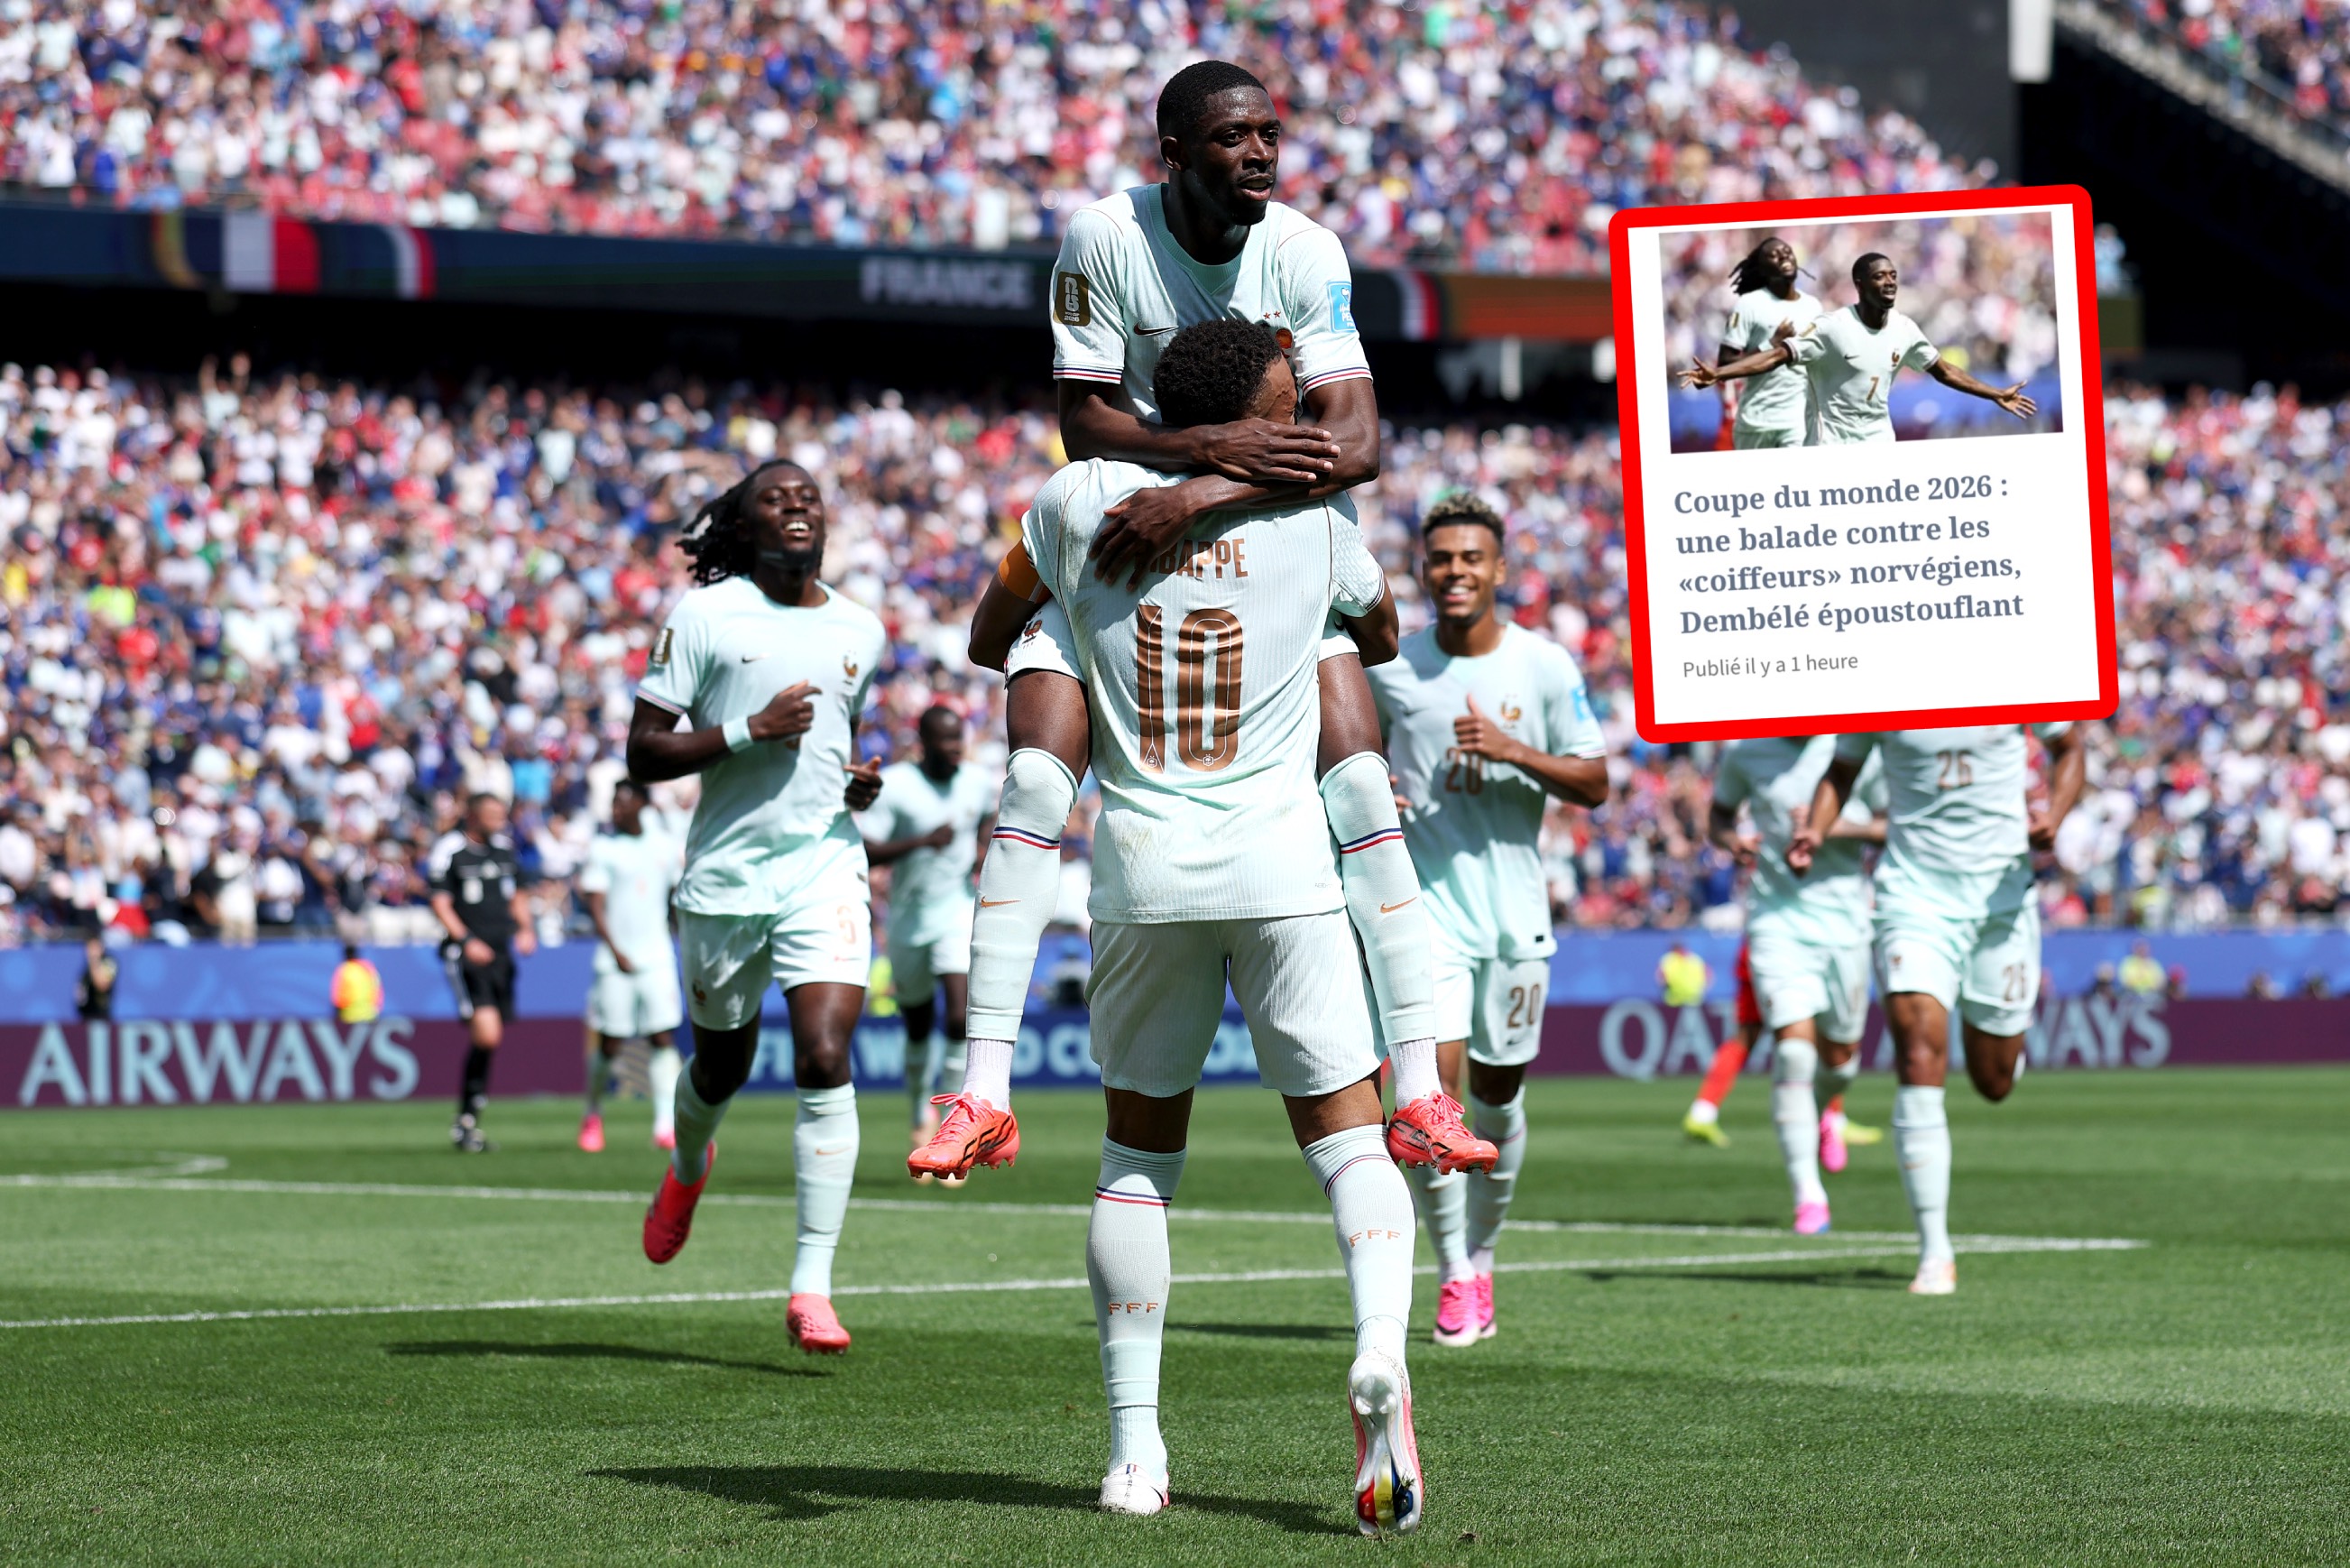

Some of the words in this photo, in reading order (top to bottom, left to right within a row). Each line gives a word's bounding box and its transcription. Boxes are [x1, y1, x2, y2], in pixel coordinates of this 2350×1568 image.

[862, 257, 1035, 309] FRANCE
[1866, 376, 1880, 402] 7
[1149, 538, 1248, 579] BAPPE
[1137, 604, 1243, 774] 10
[1445, 747, 1484, 796] 20
[1506, 982, 1542, 1029] 20
[18, 1018, 421, 1106] AIRWAYS
